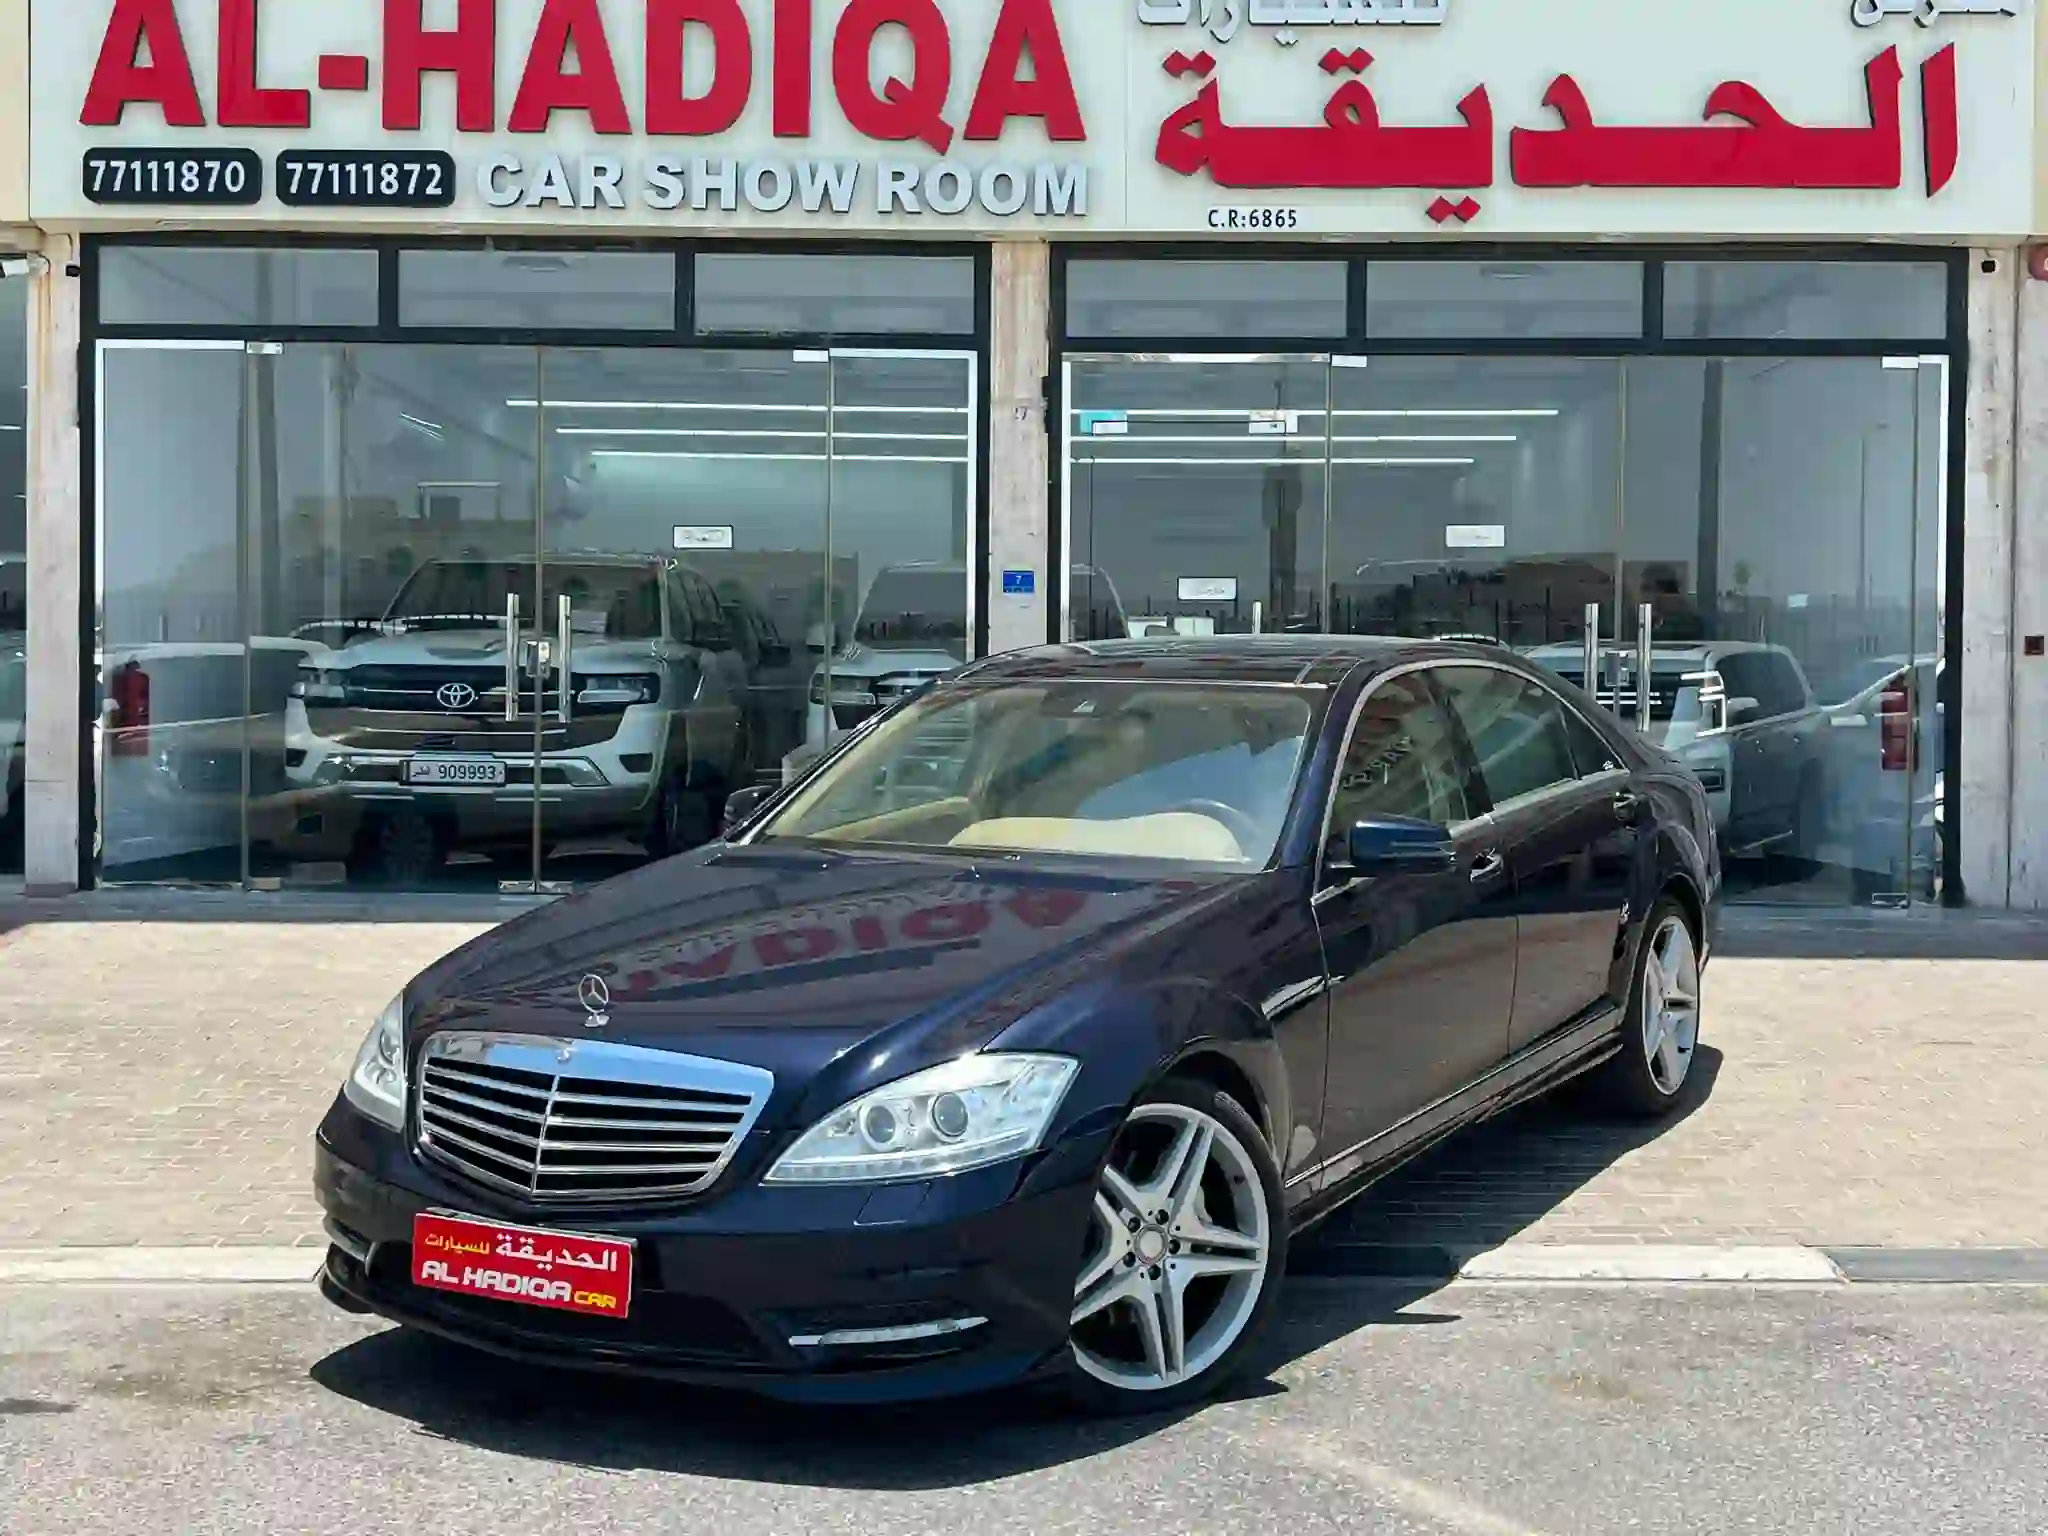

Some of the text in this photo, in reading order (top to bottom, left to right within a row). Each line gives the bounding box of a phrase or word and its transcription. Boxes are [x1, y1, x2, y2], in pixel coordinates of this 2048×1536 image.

[80, 0, 1087, 155] AL-HADIQA
[1155, 43, 1959, 223] الحديقة
[88, 159, 245, 193] 77111870
[285, 161, 443, 195] 77111872
[476, 152, 1088, 217] CAR SHOW ROOM
[1208, 208, 1297, 228] C.R:6865
[438, 764, 497, 780] 909993
[424, 1232, 619, 1272] الحديقة للسيارات
[421, 1260, 617, 1309] AL HADIQA CAR
